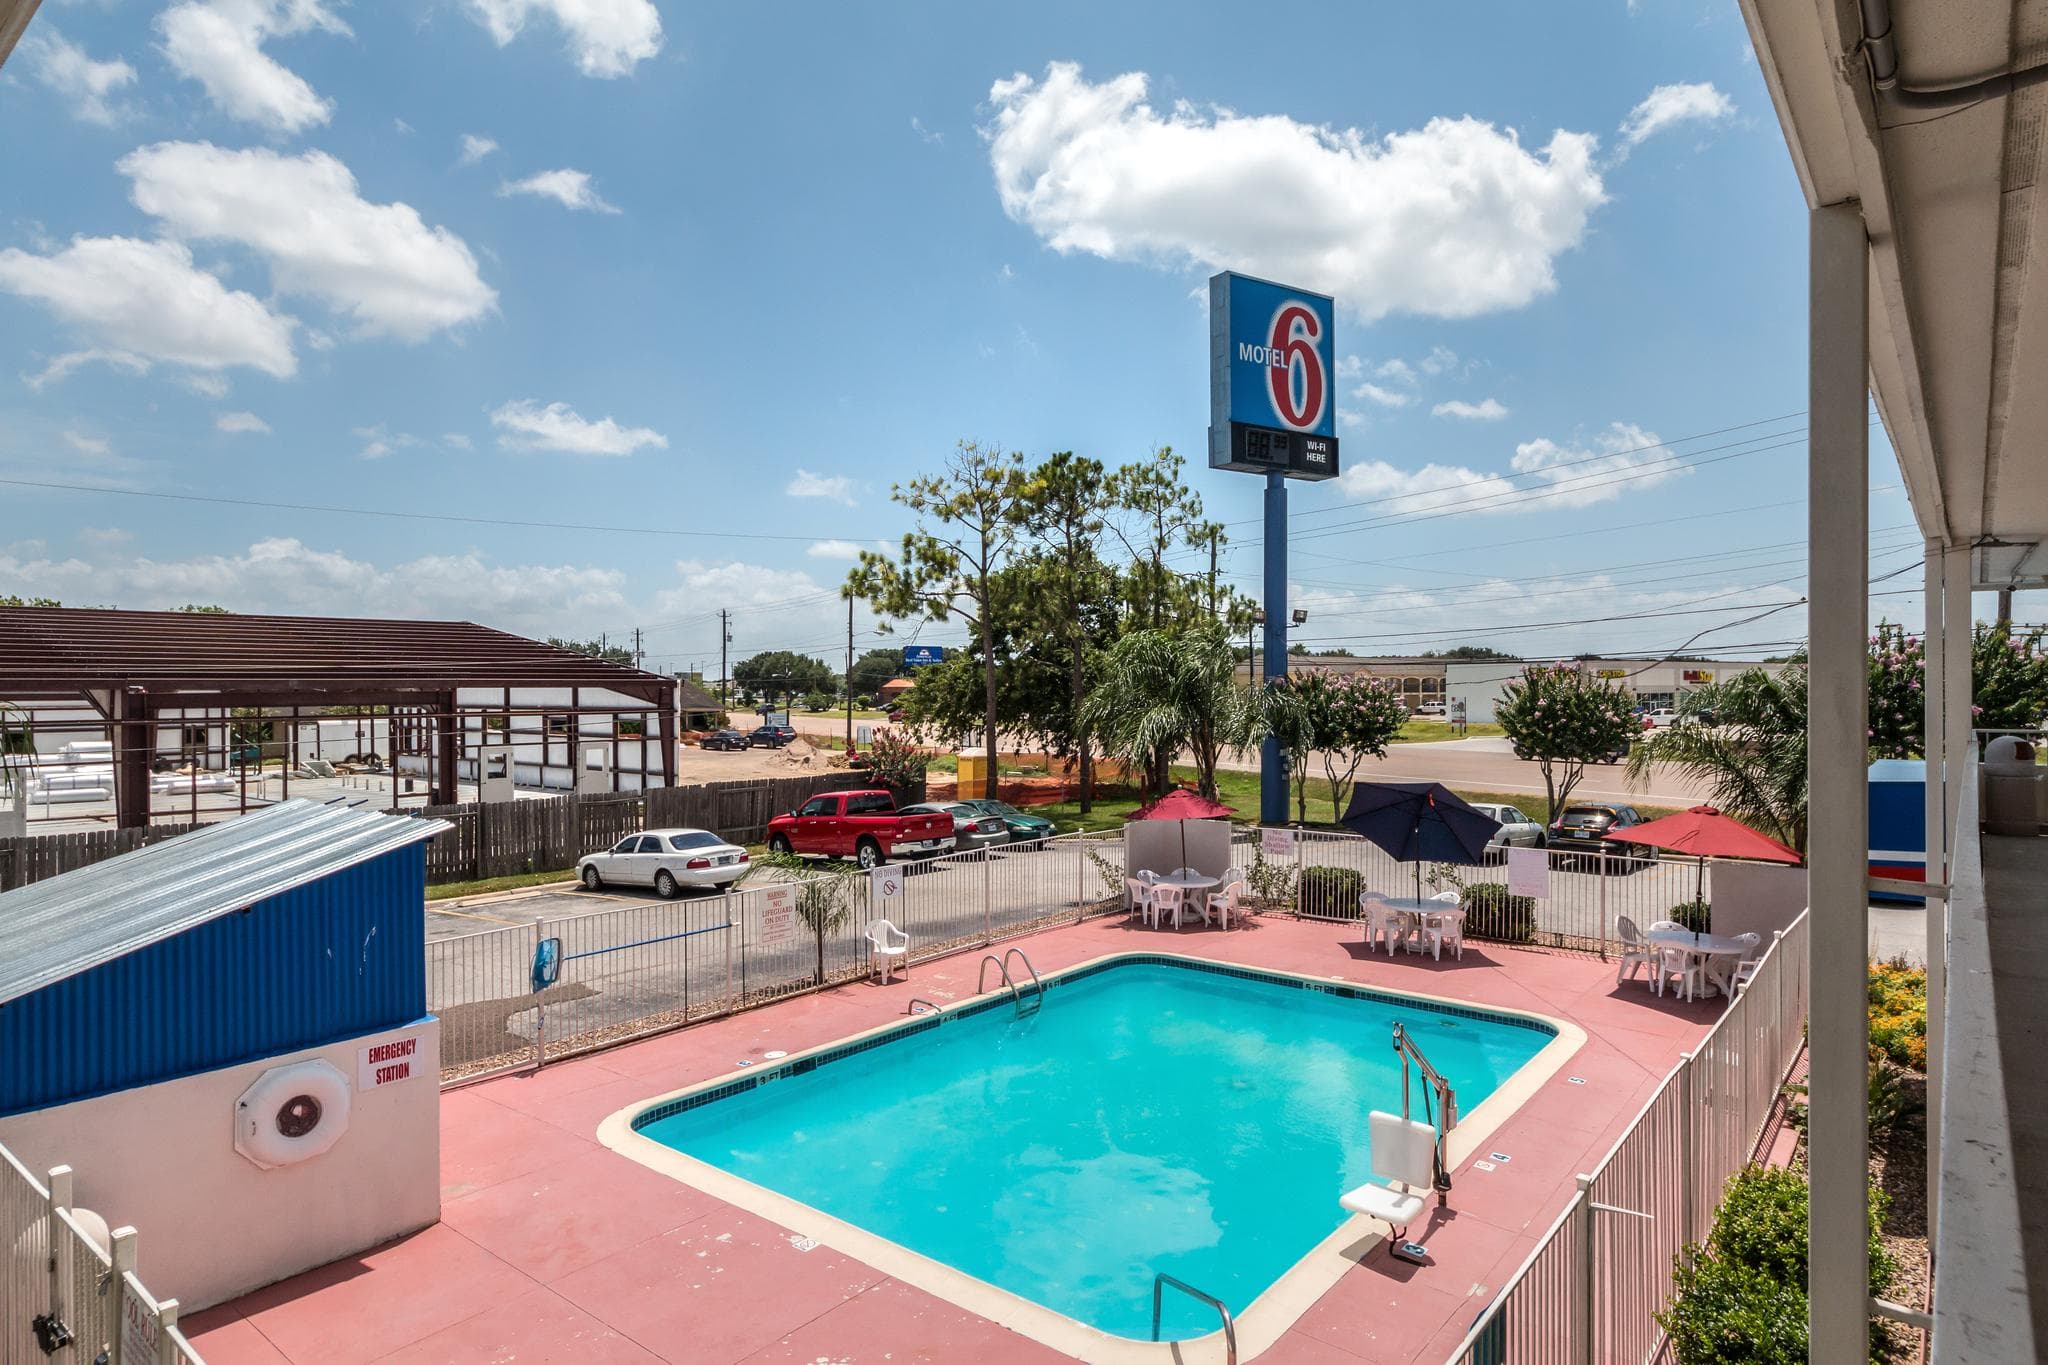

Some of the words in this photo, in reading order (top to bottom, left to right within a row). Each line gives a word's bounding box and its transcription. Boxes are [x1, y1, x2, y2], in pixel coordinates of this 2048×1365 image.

[1239, 342, 1288, 369] MOTEL
[1269, 303, 1325, 429] 6
[1306, 440, 1326, 452] WI-FI
[1306, 452, 1326, 463] HERE
[874, 870, 882, 878] NO
[884, 866, 902, 877] DIVING
[767, 890, 788, 899] WARNING
[762, 906, 793, 918] LIFEGUARD
[765, 917, 774, 925] ON
[775, 914, 789, 923] DUTY
[369, 1038, 416, 1064] EMERGENCY
[376, 1062, 410, 1085] STATION
[760, 1076, 767, 1085] 3
[769, 1071, 780, 1081] FT
[1404, 1244, 1425, 1255] 3
